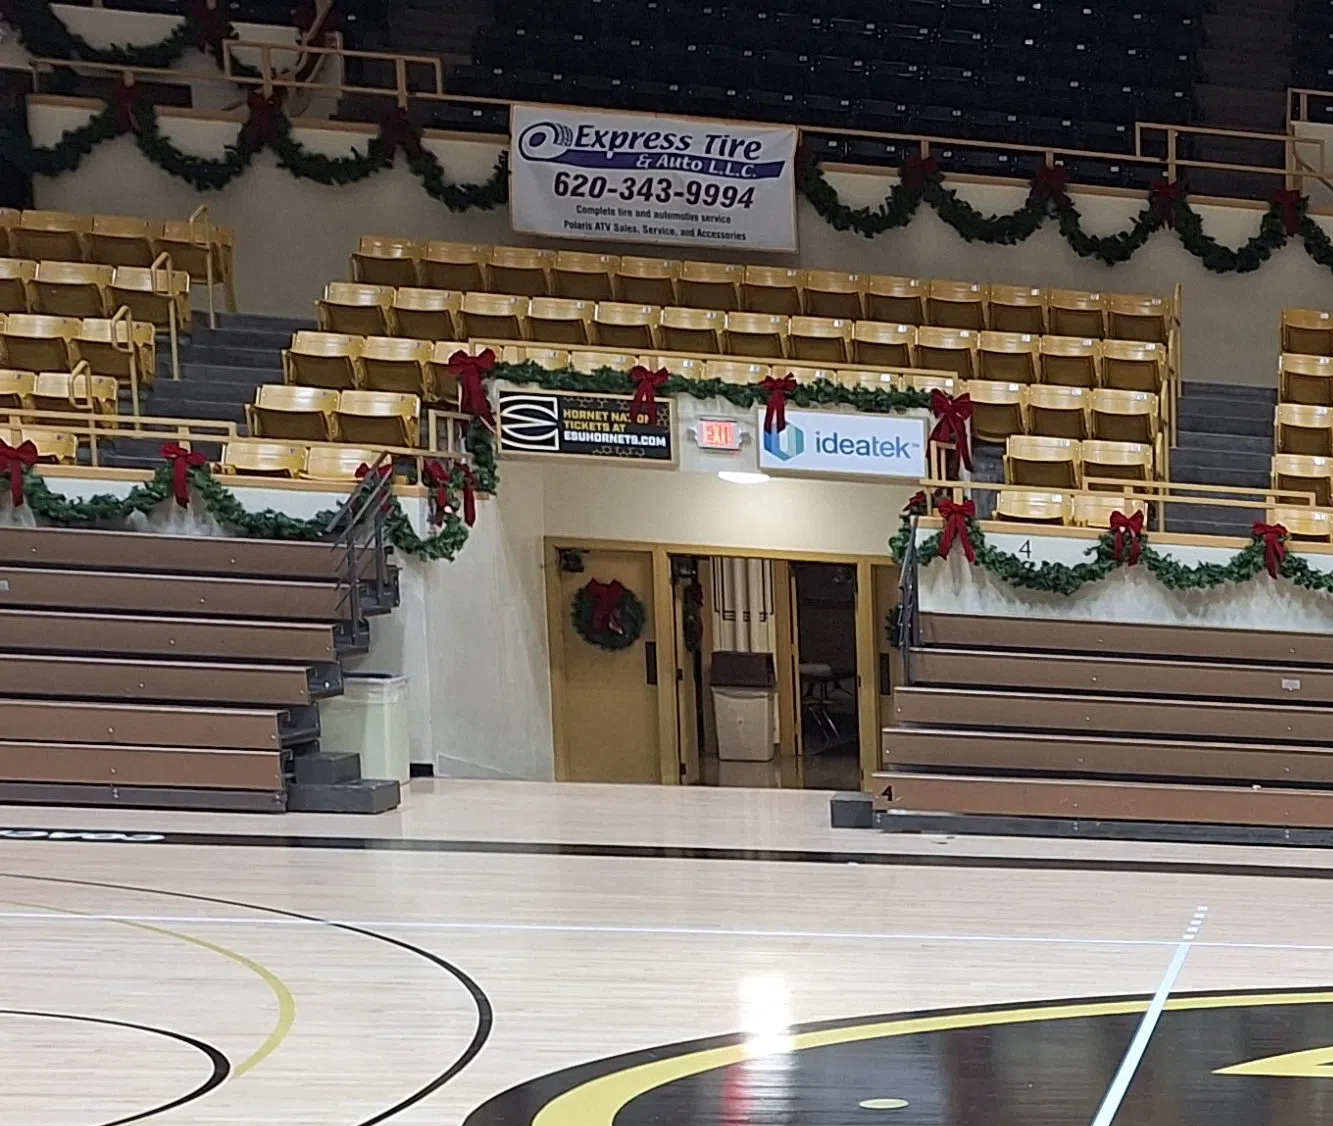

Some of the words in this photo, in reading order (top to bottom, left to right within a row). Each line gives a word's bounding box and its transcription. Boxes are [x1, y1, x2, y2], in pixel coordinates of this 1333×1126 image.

[574, 124, 694, 159] Express
[704, 133, 763, 161] Tire
[635, 153, 651, 170] &
[656, 154, 704, 172] Auto
[708, 162, 758, 179] L.L.C.
[553, 171, 756, 209] 620-343-9994
[576, 204, 616, 217] Complete
[617, 207, 633, 218] tire
[635, 208, 651, 219] and
[654, 209, 700, 222] automotive
[700, 213, 732, 224] service
[563, 219, 593, 232] Polaris
[594, 222, 612, 232] ATV
[613, 223, 641, 235] Sales,
[642, 225, 679, 238] Service,
[680, 227, 695, 238] and
[696, 229, 747, 241] Accessories
[563, 408, 609, 421] HORNET
[563, 420, 610, 432] TICKETS
[612, 424, 627, 433] AT
[703, 422, 734, 446] EXIT
[563, 431, 667, 447] ESUHORNETS.COM
[815, 430, 912, 459] ideatek
[1018, 539, 1033, 559] 4
[880, 785, 894, 802] 4
